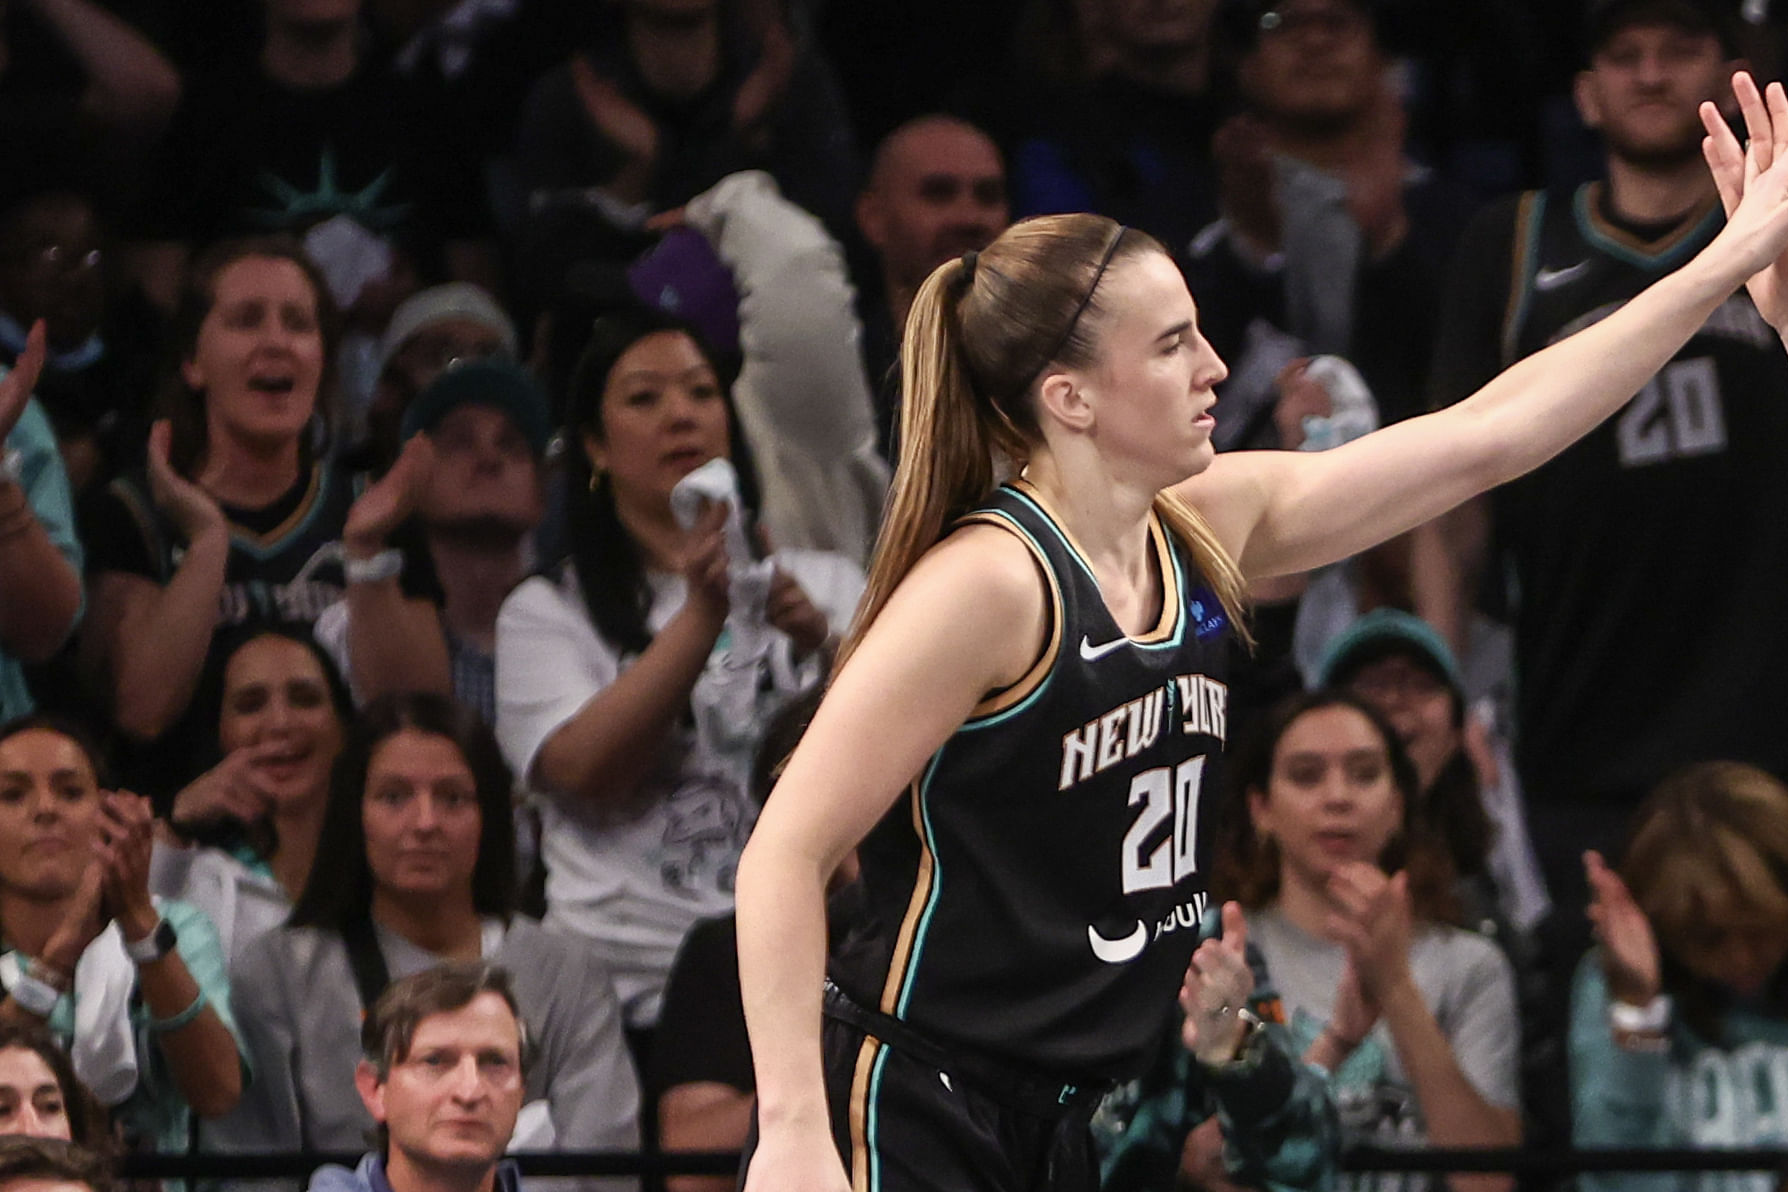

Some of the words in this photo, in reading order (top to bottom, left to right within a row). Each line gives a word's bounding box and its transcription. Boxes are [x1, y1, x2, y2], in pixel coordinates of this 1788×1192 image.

[1058, 686, 1165, 791] NEW
[1175, 673, 1228, 752] YOR
[1122, 754, 1207, 895] 20
